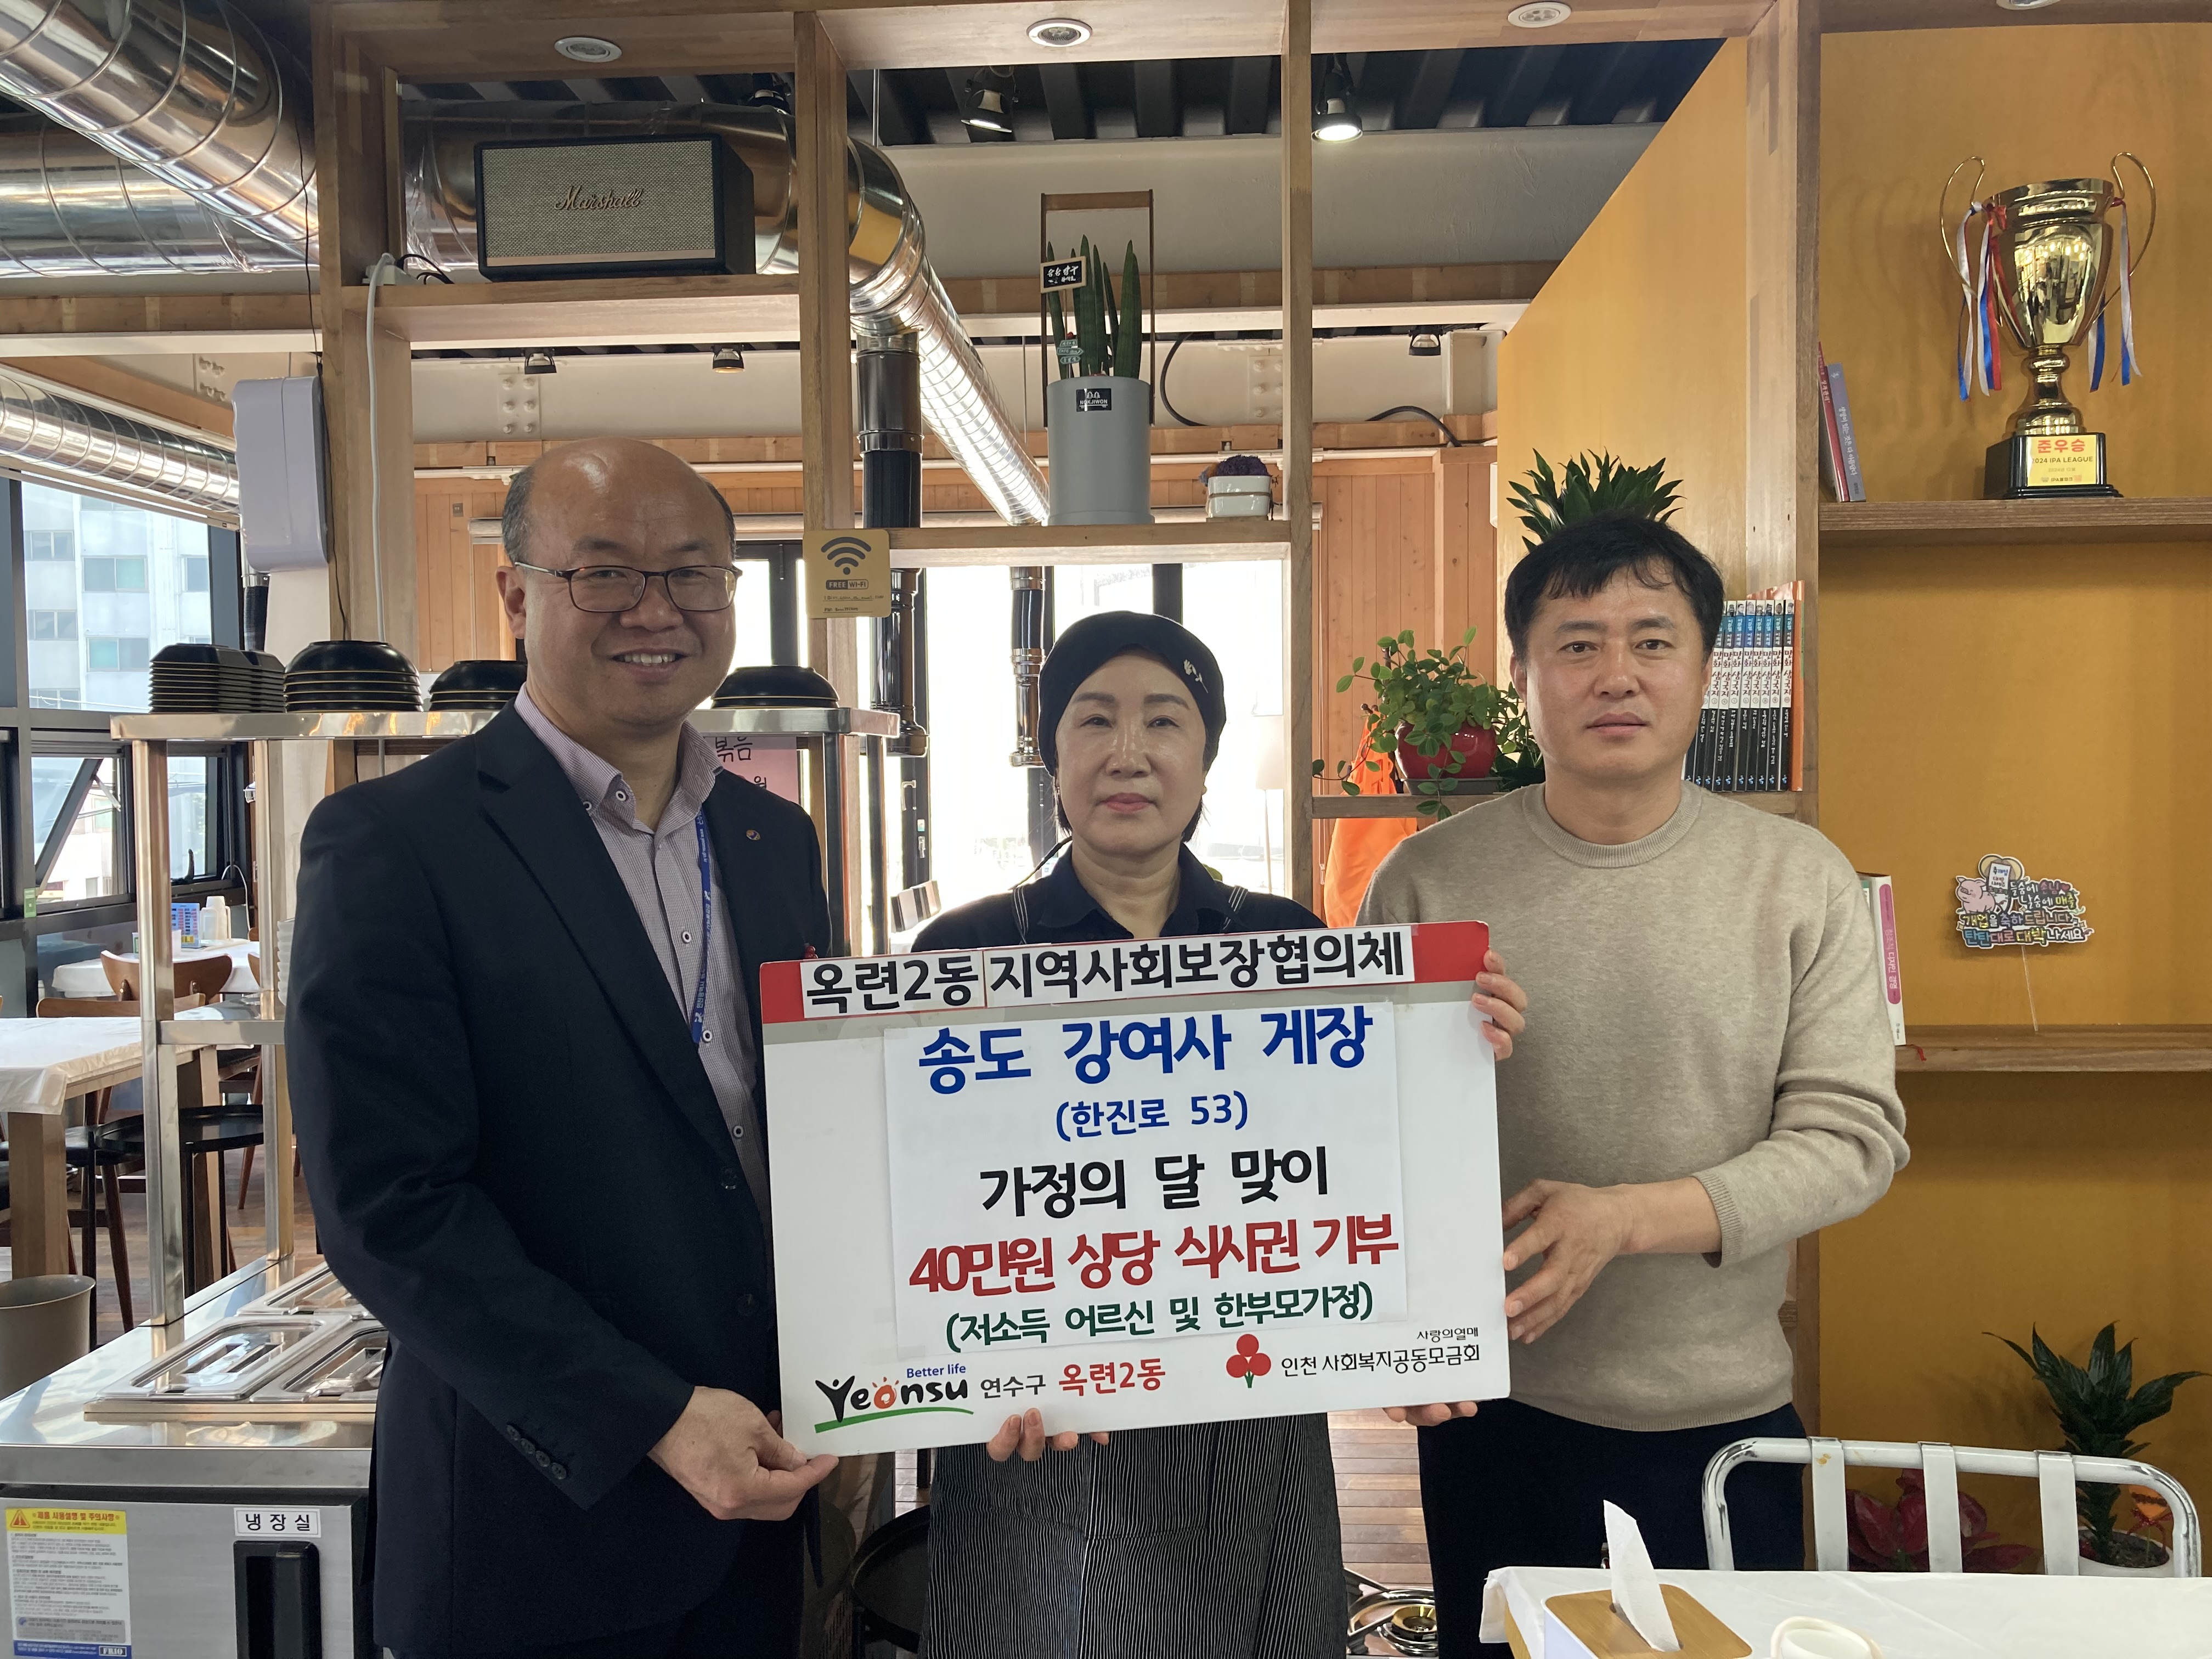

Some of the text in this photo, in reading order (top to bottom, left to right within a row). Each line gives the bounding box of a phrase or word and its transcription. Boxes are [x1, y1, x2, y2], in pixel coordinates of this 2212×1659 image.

[554, 185, 642, 210] Marshall
[1839, 407, 1848, 422] 생명이
[1842, 423, 1849, 435] 있는
[1844, 435, 1852, 446] 것은
[2038, 439, 2085, 453] 준우승
[1847, 454, 1858, 476] 아름답다
[1713, 651, 1722, 667] 만화
[1723, 652, 1733, 668] 만화
[1733, 651, 1742, 667] 만화
[1743, 651, 1753, 667] 만화
[1753, 651, 1762, 667] 만화
[1763, 651, 1771, 667] 만화
[1773, 650, 1782, 667] 만화
[1784, 650, 1793, 666] 만화
[1711, 671, 1721, 697] 삼국지
[1721, 672, 1730, 697] 삼국지
[1731, 670, 1740, 696] 삼국지
[1743, 671, 1752, 696] 삼국지
[1752, 671, 1761, 696] 삼국지
[1762, 671, 1771, 696] 삼국지
[1771, 670, 1781, 695] 삼국지
[1784, 670, 1792, 695] 삼국지
[2010, 881, 2059, 896] 들숨에 손님
[2021, 893, 2076, 910] 날숨에 매출
[1963, 914, 1997, 928] 개업을
[1965, 930, 2015, 946] 탄탄대로
[1887, 952, 1896, 973] 디자인
[806, 932, 1404, 1014] 옥련2동 지역사회보장협의체
[1889, 975, 1897, 989] 경영
[919, 1005, 1373, 1094] 송도 강여사 게장
[1056, 1090, 1248, 1142] (한진로 53)
[980, 1146, 1328, 1219] 가정의 달 맞이
[909, 1214, 1399, 1296] 40만원 상당 식사권 기부
[946, 1281, 1373, 1353] (저소득 어르신 및 한부모가정)
[1417, 1327, 1479, 1343] 사랑의열매
[1281, 1344, 1480, 1377] 인천 사회복지공동모금회
[906, 1363, 967, 1378] Better life
[980, 1358, 1166, 1399] 연수구 옥련2동
[815, 1375, 968, 1422] Yeonsu
[103, 1646, 123, 1655] FRIO
